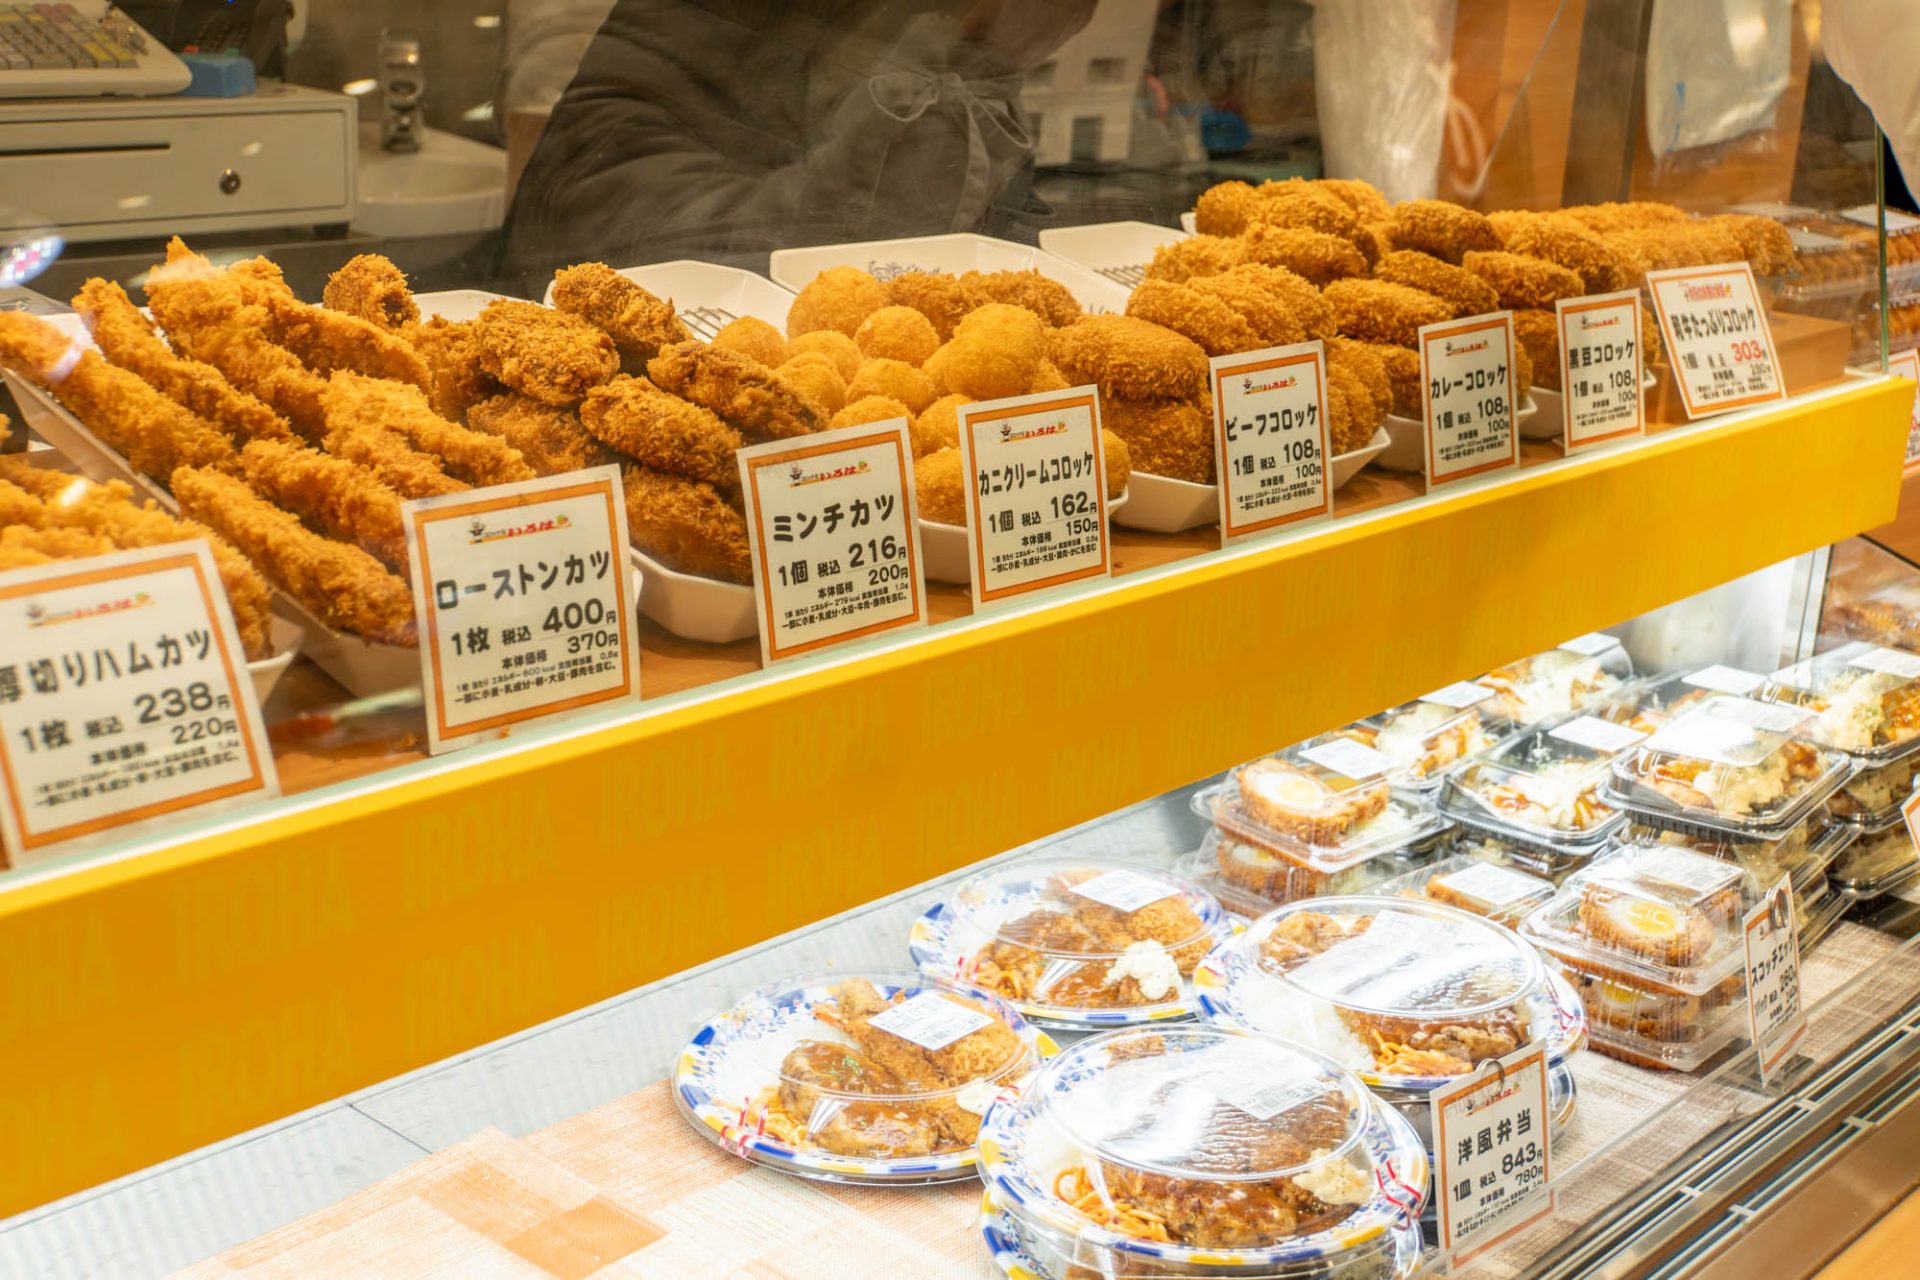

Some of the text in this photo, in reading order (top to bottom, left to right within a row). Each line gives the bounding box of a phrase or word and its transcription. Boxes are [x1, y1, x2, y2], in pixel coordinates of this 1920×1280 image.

[1569, 340, 1635, 370] 黒豆コロッケ
[1431, 364, 1506, 399] カレーコロッケ
[1573, 380, 1588, 397] 1個
[1226, 403, 1317, 441] ビーフコロッケ
[1436, 411, 1453, 430] 1個
[979, 451, 1094, 496] カニクリームコロッケ
[1234, 439, 1320, 476] 1個 税込 108円
[1260, 463, 1322, 488] 本体価格 100円
[508, 520, 555, 538] いろは
[773, 495, 895, 542] ミンチカツ
[989, 491, 1097, 533] 1個 税込 162円
[1022, 518, 1098, 547] 本体価格 150円
[436, 550, 610, 610] ローストンカツ
[778, 536, 907, 586] 1個 税込 216円
[818, 564, 908, 599] 本体価格 200円
[451, 598, 617, 656] 1枚 税込 400円
[0, 629, 211, 703] 厚切りハムカツ
[502, 630, 618, 670] 本体価格 370円
[20, 682, 231, 752] 1枚 税込 238円
[90, 717, 238, 765] 本体価格 220円
[172, 840, 358, 986] IROHA
[402, 783, 561, 914] IROHA
[600, 731, 737, 858] IROHA
[768, 690, 893, 799] IROHA
[180, 988, 356, 1134] IROHA
[401, 920, 557, 1049] IROHA
[596, 862, 729, 975] IROHA
[1458, 1108, 1531, 1166] 洋風弁当
[1453, 1142, 1543, 1202] 1皿 税込 843円
[1479, 1165, 1544, 1207] 本体価格 780円
